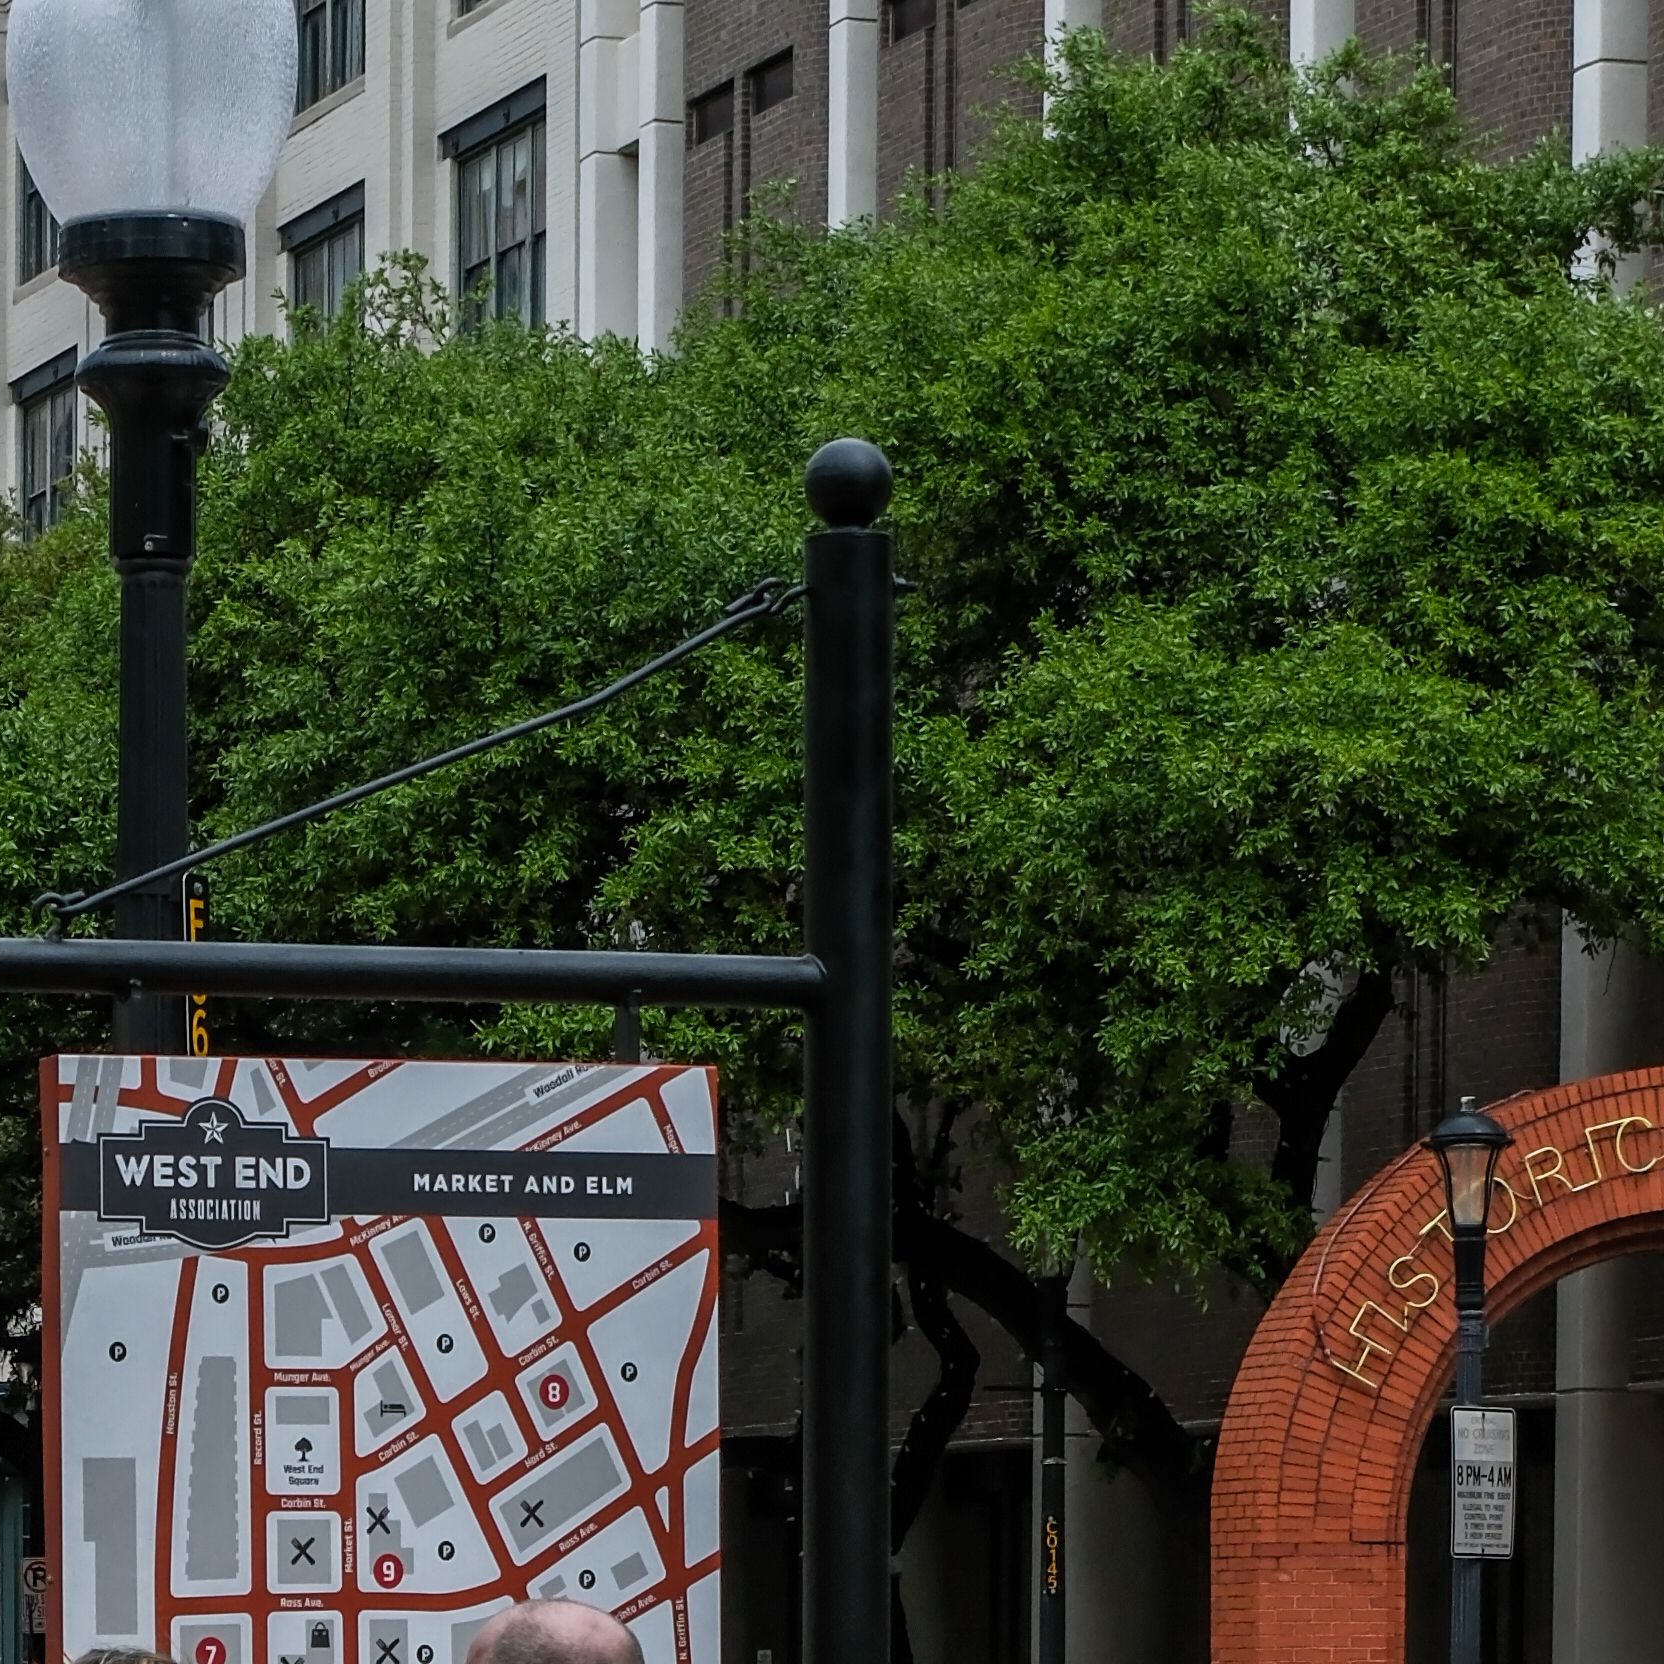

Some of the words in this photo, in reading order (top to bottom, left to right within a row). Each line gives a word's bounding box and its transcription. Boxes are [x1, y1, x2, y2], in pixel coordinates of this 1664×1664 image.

[189, 899, 209, 1057] F6
[114, 1154, 223, 1188] WEST
[235, 1156, 312, 1190] END
[413, 1173, 514, 1193] MARKET
[524, 1175, 576, 1194] AND
[586, 1176, 633, 1195] ELM
[169, 1198, 261, 1221] ASSOCIATION
[349, 1218, 393, 1247] McKinney
[274, 1371, 309, 1383] Munger
[311, 1372, 331, 1382] Ave.
[547, 1382, 561, 1402] 8
[165, 1390, 177, 1435] Houston
[1458, 1428, 1469, 1439] NO
[253, 1427, 263, 1466] Record
[283, 1465, 309, 1475] West
[310, 1465, 324, 1474] End
[288, 1476, 320, 1486] Square
[1457, 1465, 1464, 1486] 8
[1497, 1466, 1512, 1488] AM
[312, 1499, 326, 1508] St.
[344, 1534, 353, 1573] Market
[382, 1561, 395, 1581] 9
[304, 1598, 324, 1608] Ave.
